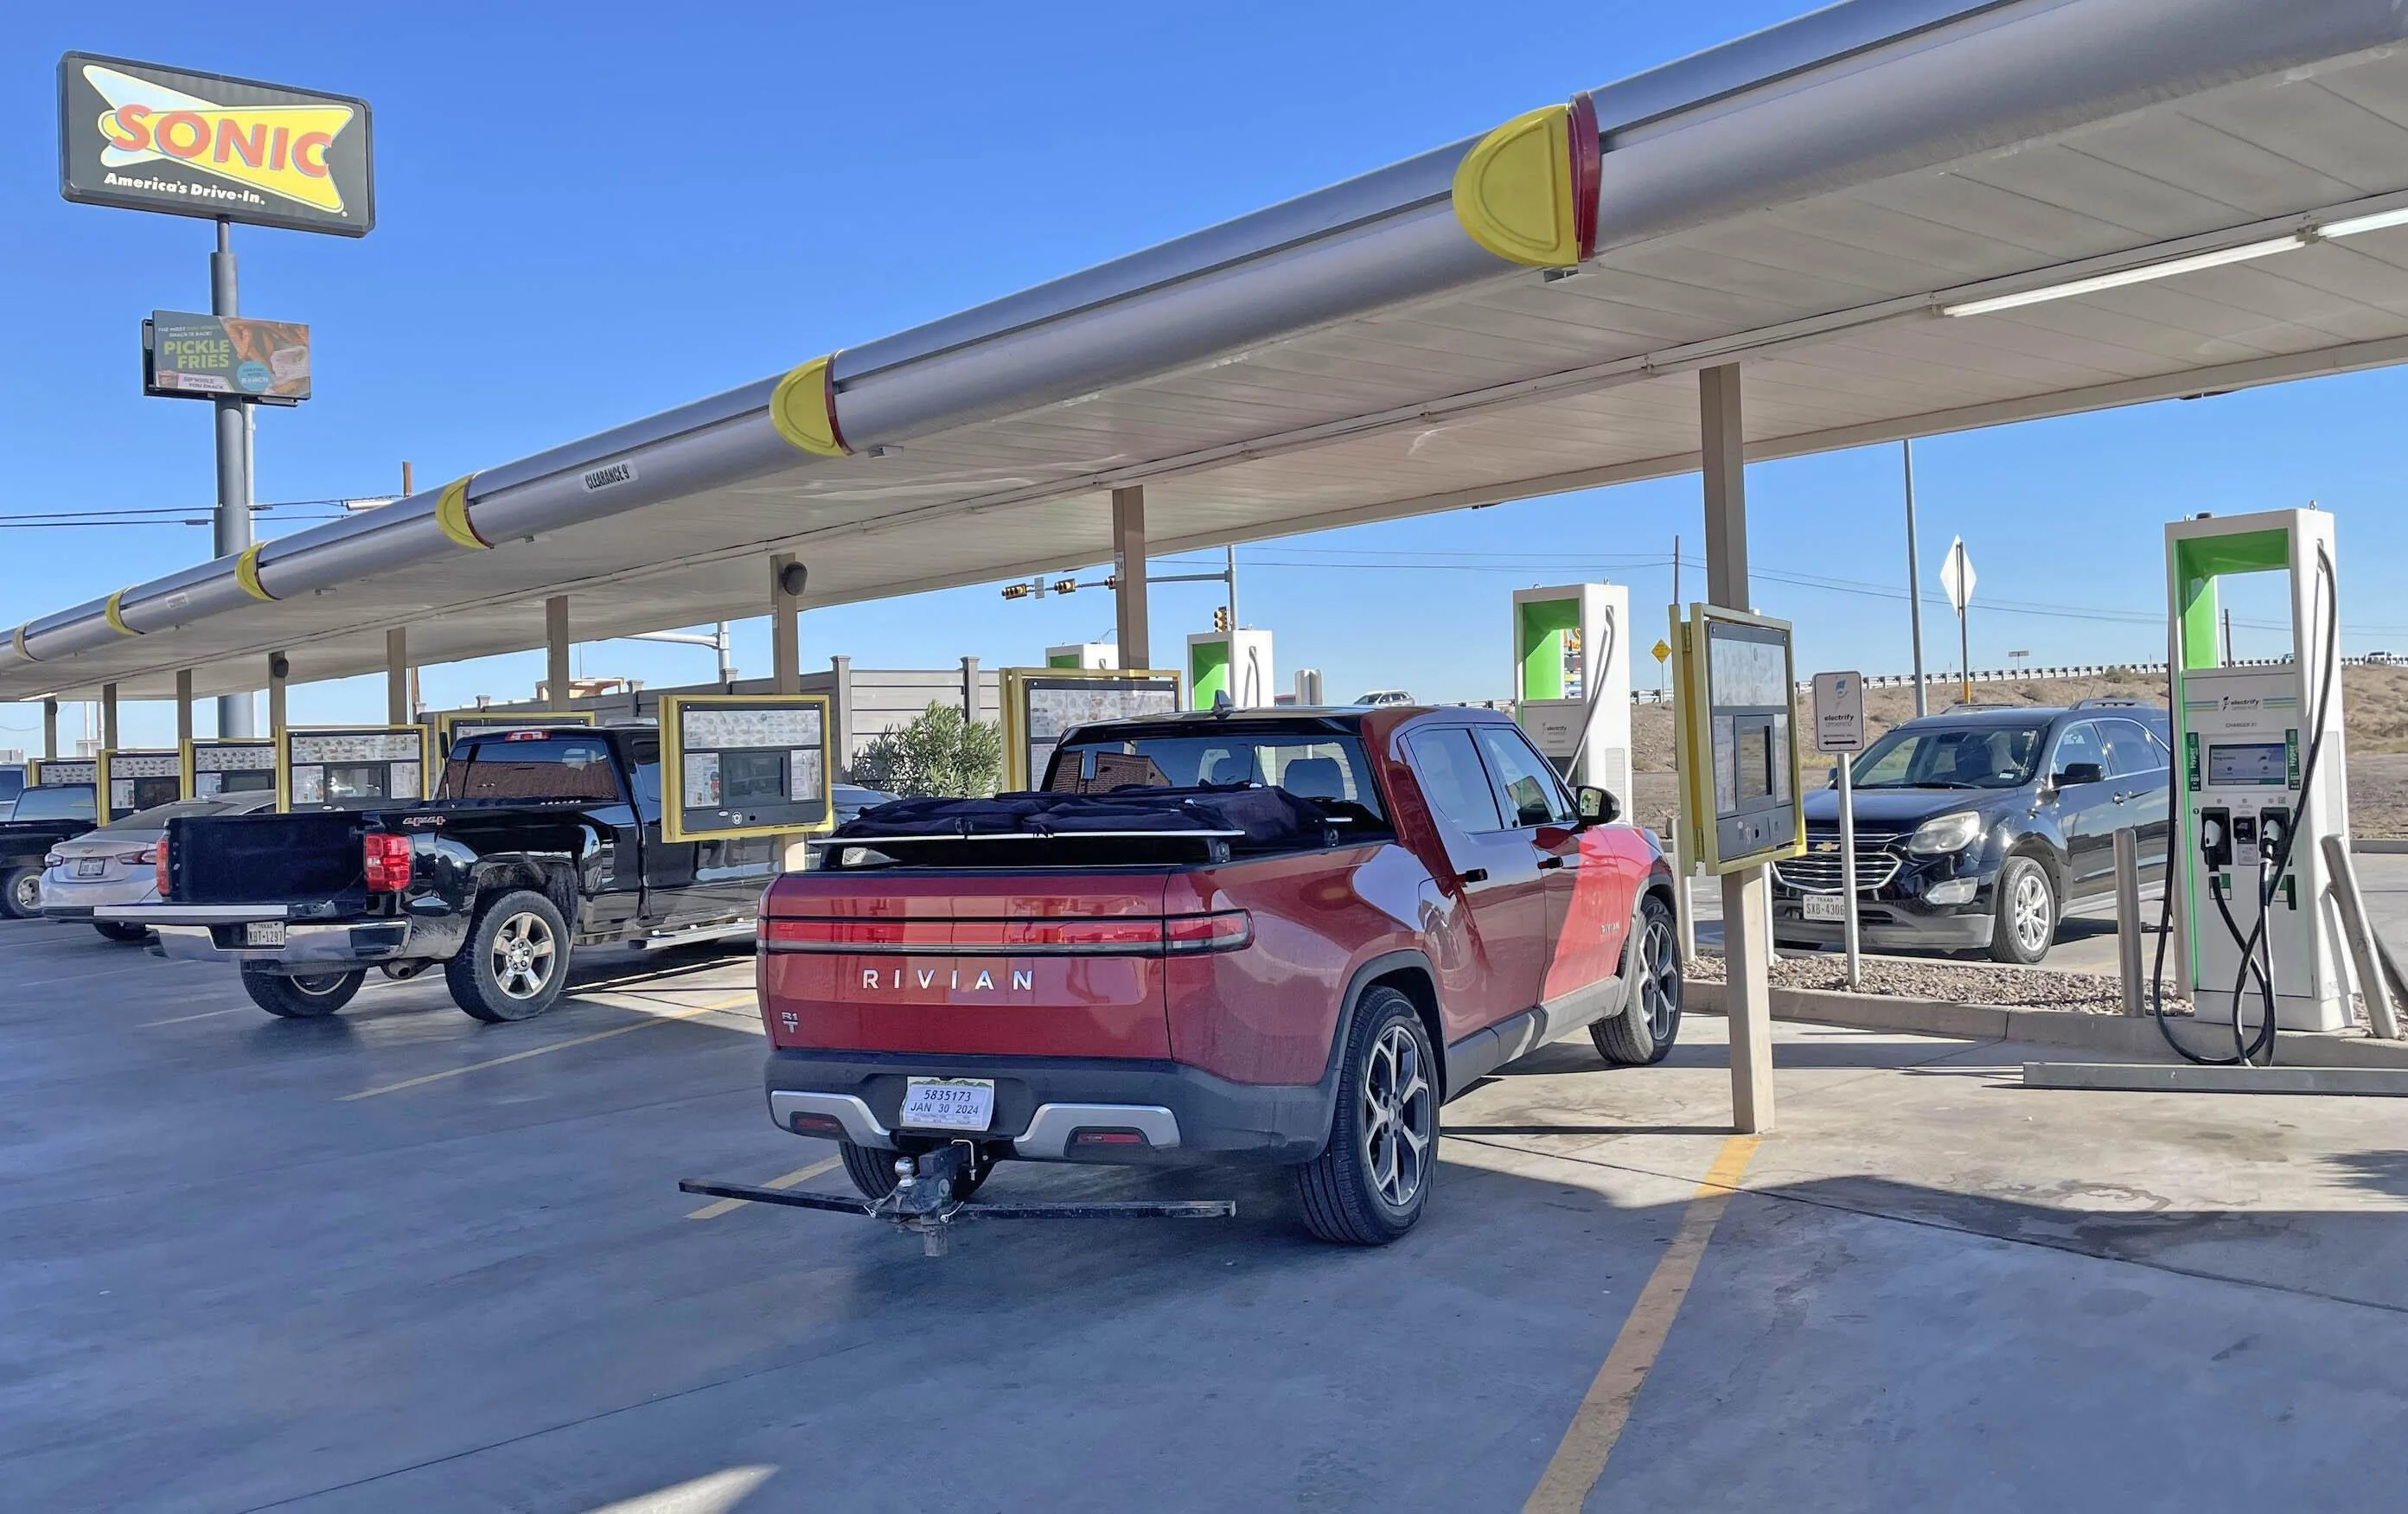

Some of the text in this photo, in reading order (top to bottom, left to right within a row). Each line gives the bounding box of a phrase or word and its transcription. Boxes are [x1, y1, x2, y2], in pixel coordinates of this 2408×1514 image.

[109, 104, 332, 178] SONIC
[104, 172, 188, 195] America's
[164, 339, 230, 355] PICKLE
[176, 355, 229, 369] FRIES
[584, 466, 624, 489] CLEARANCE
[862, 968, 1033, 991] RIVIAN
[923, 1089, 972, 1102] 5835173
[910, 1102, 979, 1115] JAN 30 2024
